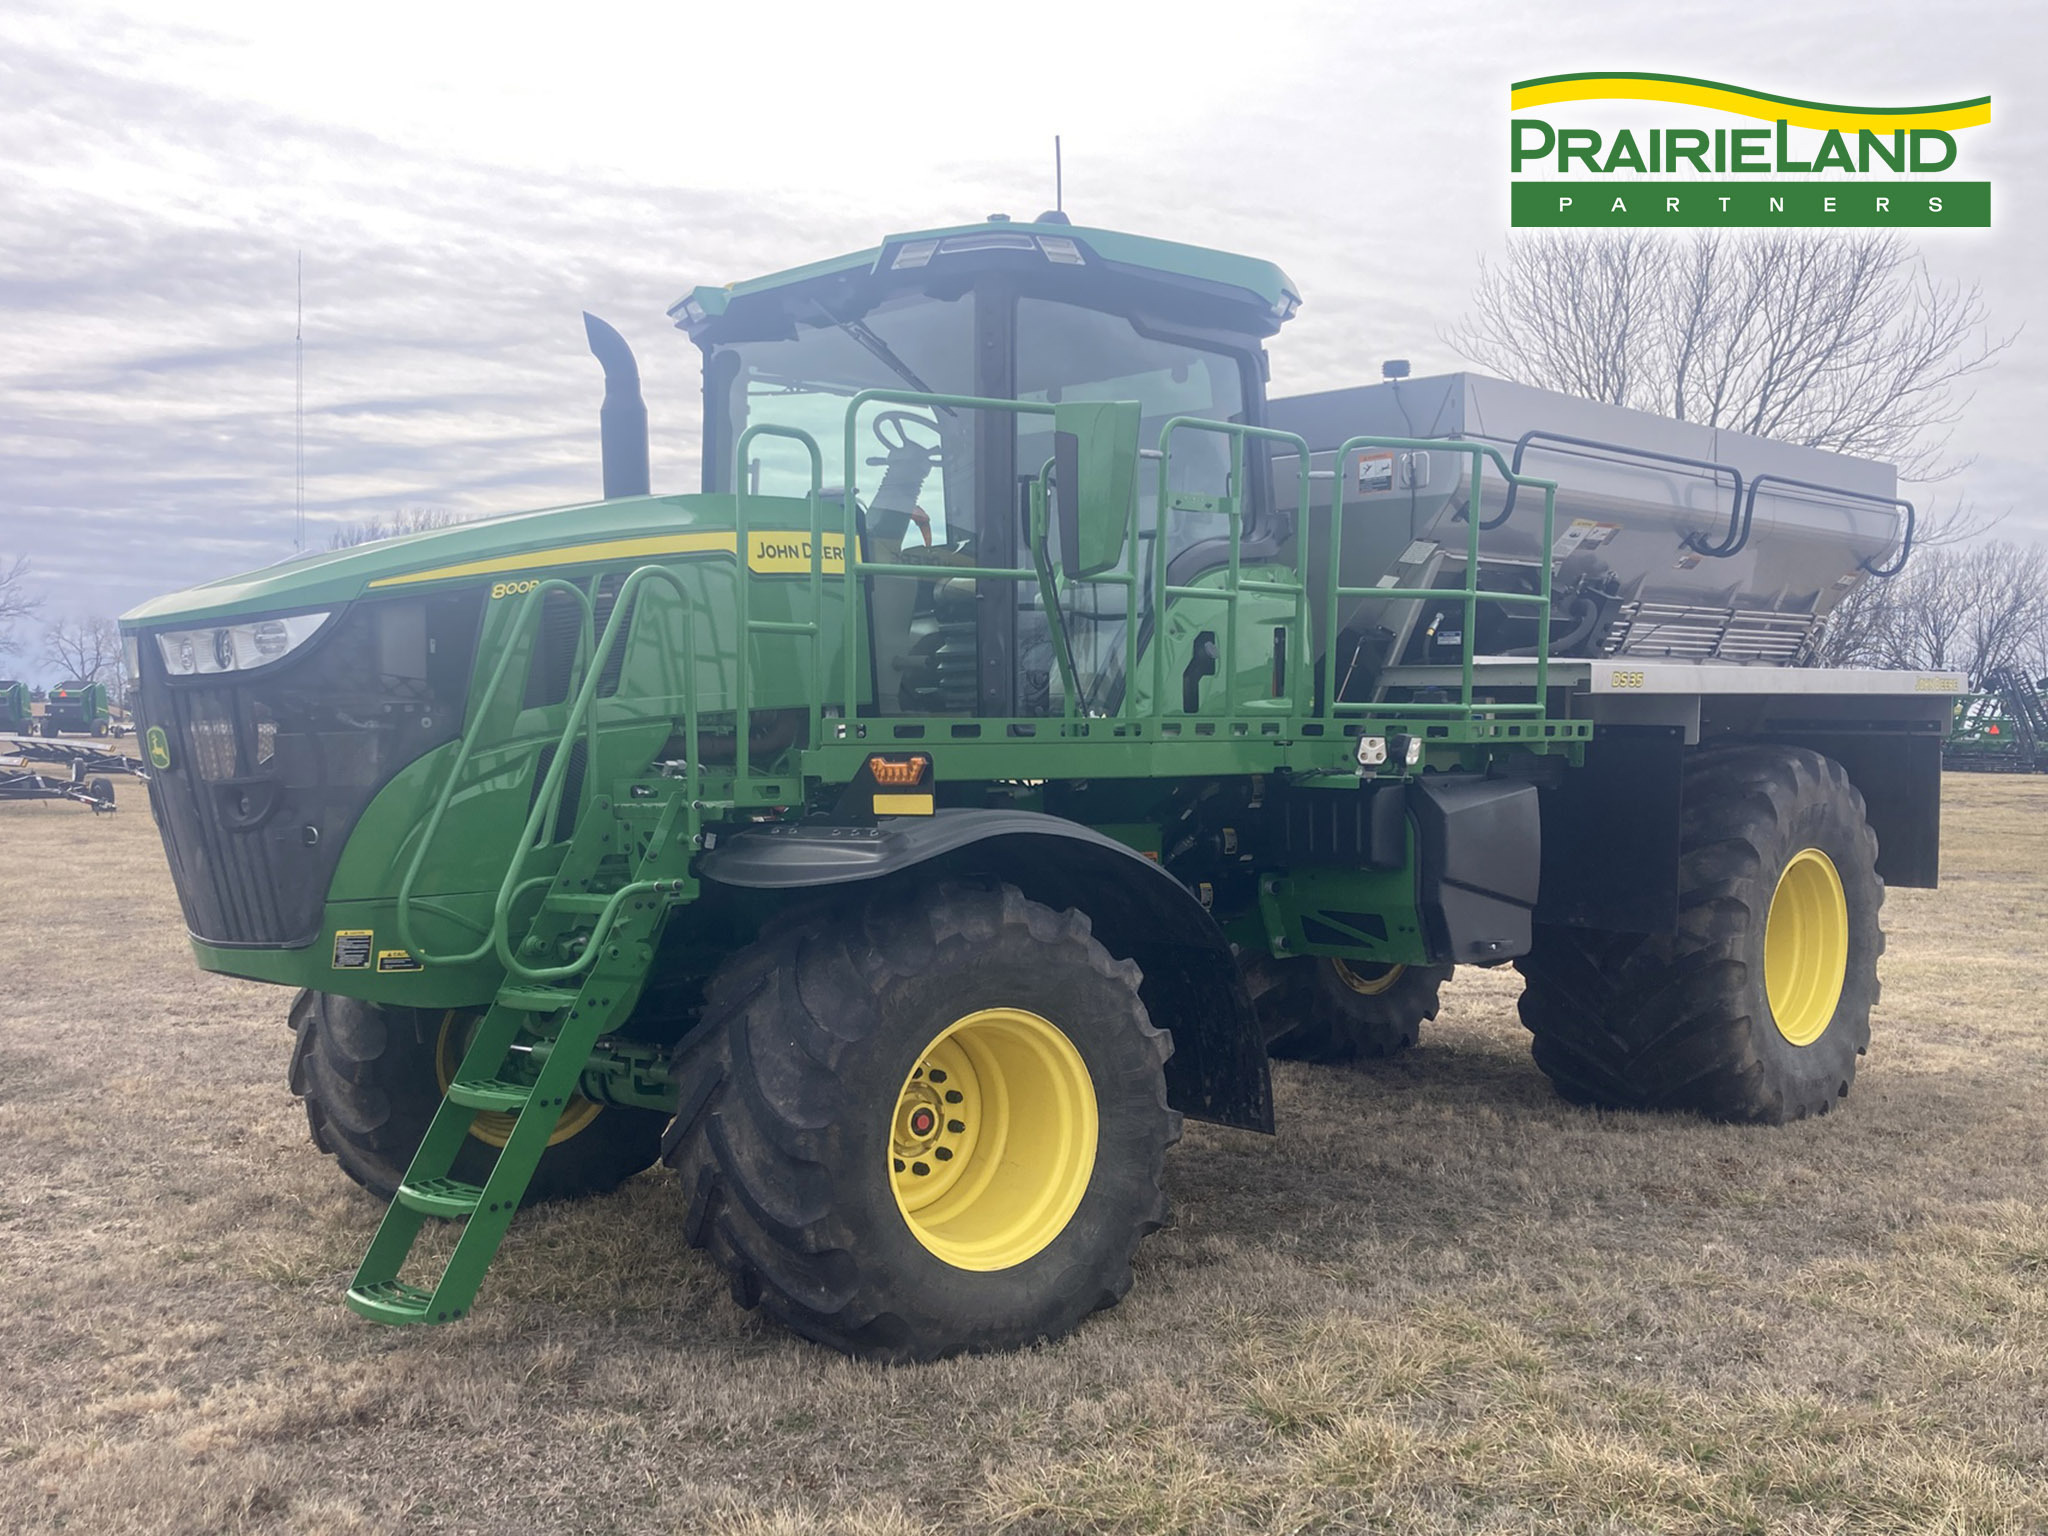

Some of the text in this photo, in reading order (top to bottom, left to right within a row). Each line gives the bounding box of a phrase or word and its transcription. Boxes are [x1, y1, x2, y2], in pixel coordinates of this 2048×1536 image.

[757, 542, 845, 560] JOHN DER
[1611, 671, 1644, 688] DS 35
